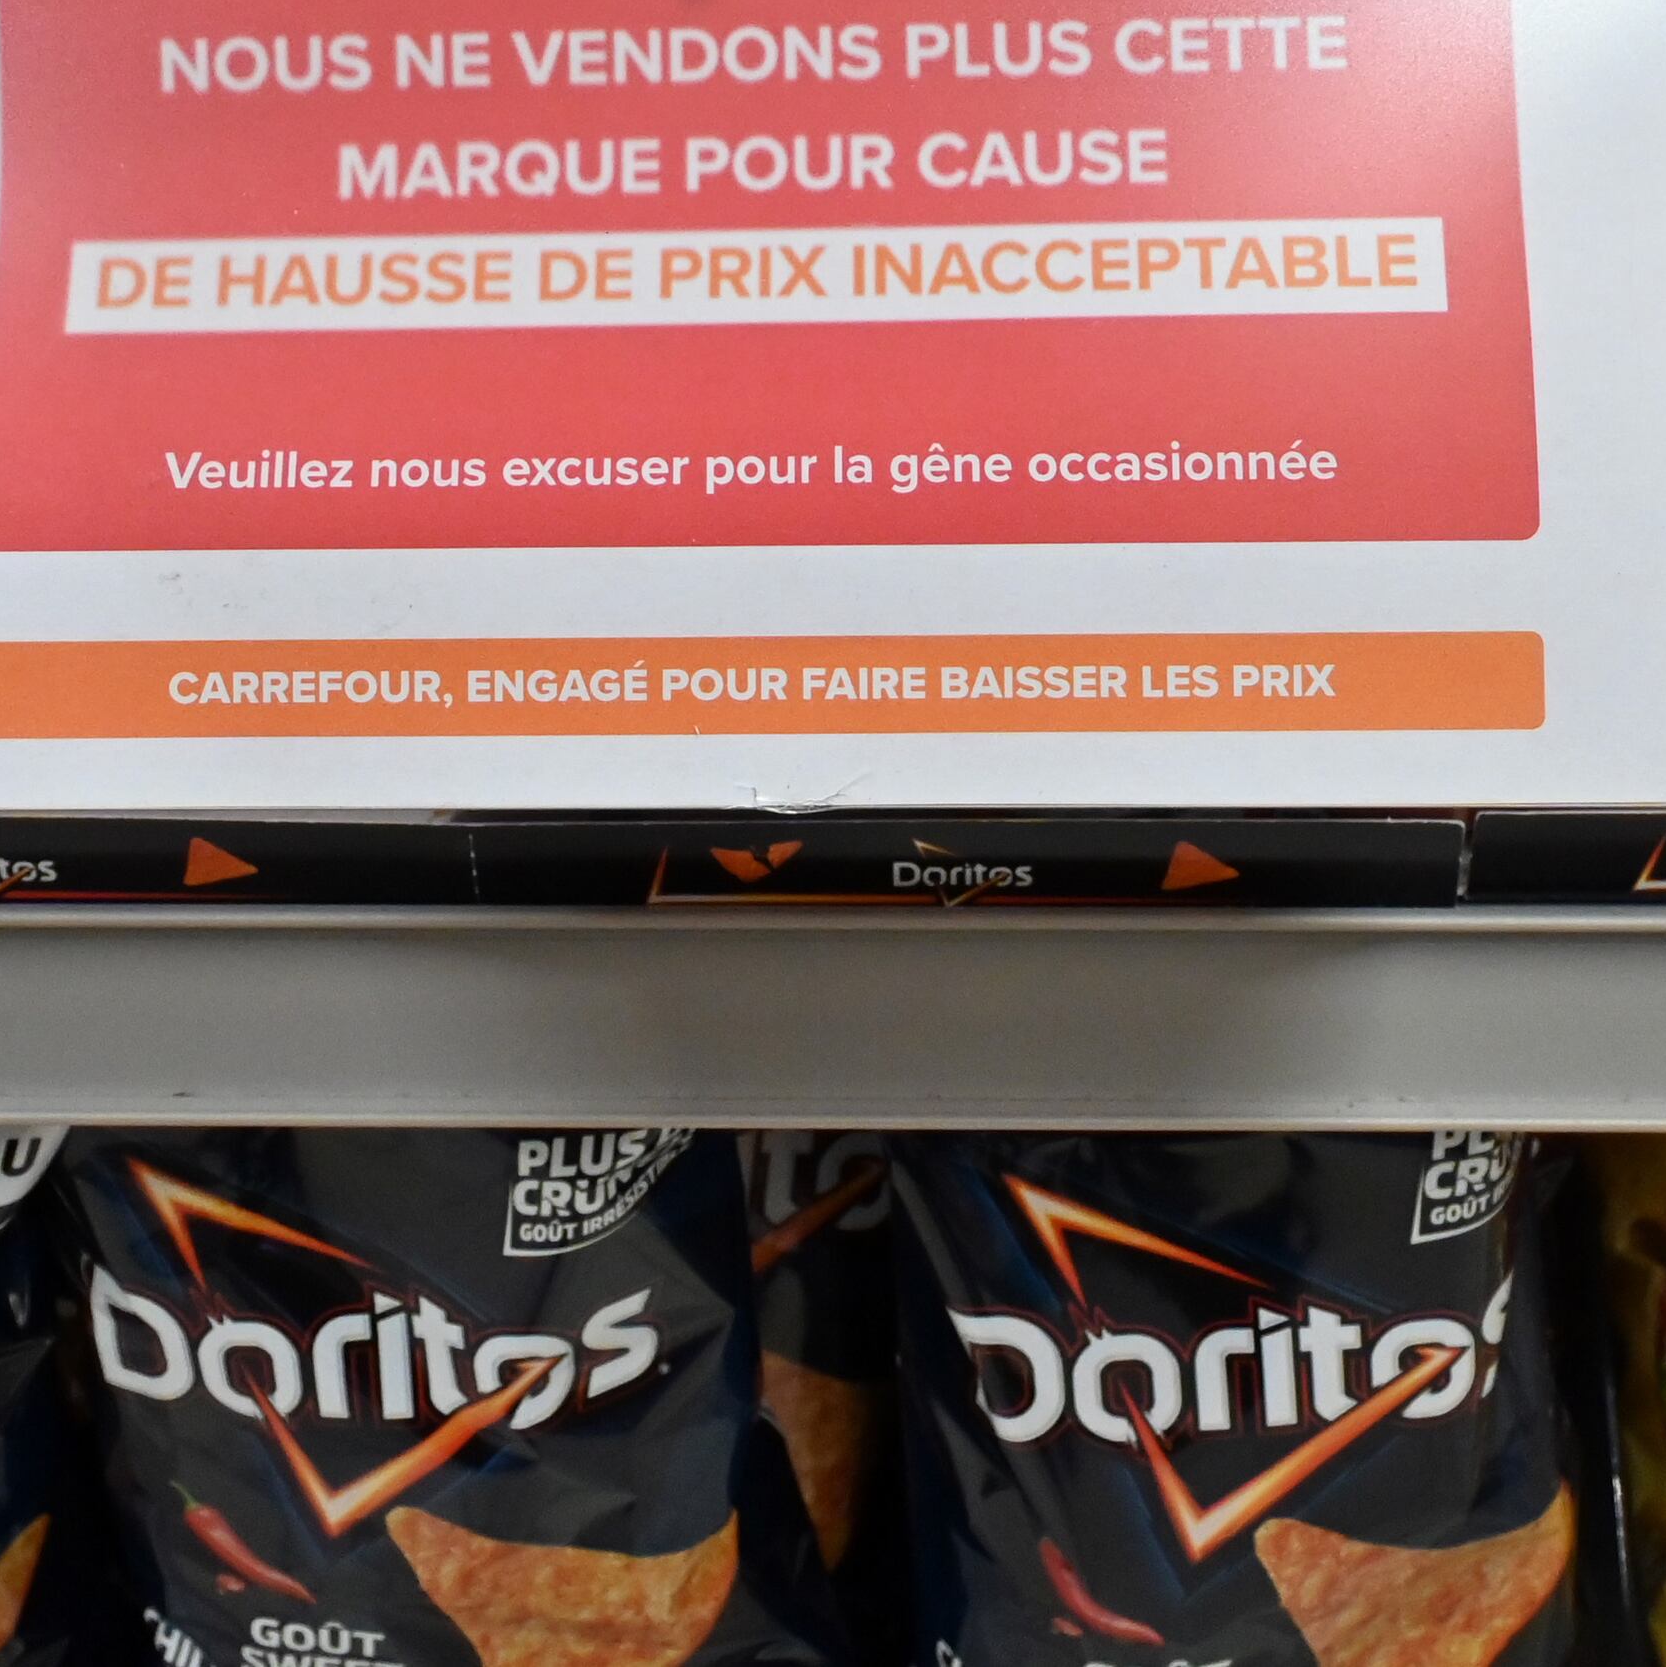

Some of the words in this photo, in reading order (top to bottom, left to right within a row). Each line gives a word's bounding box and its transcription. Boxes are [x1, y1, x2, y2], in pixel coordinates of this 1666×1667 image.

[159, 34, 373, 95] NOUS
[393, 32, 490, 90] NE
[511, 24, 881, 88] VENDONS
[905, 19, 1092, 80] PLUS
[1113, 15, 1349, 75] CETTE
[338, 137, 661, 203] MARQUE
[685, 132, 895, 193] POUR
[916, 128, 1169, 188] CAUSE
[94, 255, 193, 309] DE
[216, 250, 514, 308] HAUSSE
[538, 248, 634, 302] DE
[658, 242, 828, 300] PRIX
[851, 233, 1420, 296] INACCEPTABLE
[164, 450, 354, 490] Veuillez
[370, 456, 489, 488] nous
[502, 454, 690, 487] excuser
[705, 449, 817, 495] pour
[833, 445, 874, 485] la
[890, 441, 1013, 494] gêne
[1027, 439, 1338, 483] occasionnée
[168, 669, 454, 709] CARREFOUR,
[466, 659, 648, 704] ENGAGÉ
[661, 666, 788, 702] POUR
[802, 665, 927, 701] FAIRE
[939, 664, 1128, 701] BAISSER
[1140, 663, 1219, 699] LES
[1231, 661, 1337, 698] PRIX
[893, 860, 1033, 888] Doritos
[517, 1128, 649, 1179] PLUS
[519, 1218, 580, 1243] GOÛT
[1429, 1192, 1492, 1225] GOÛT
[89, 1262, 660, 1431] Doritos
[250, 1617, 385, 1657] GOÛT
